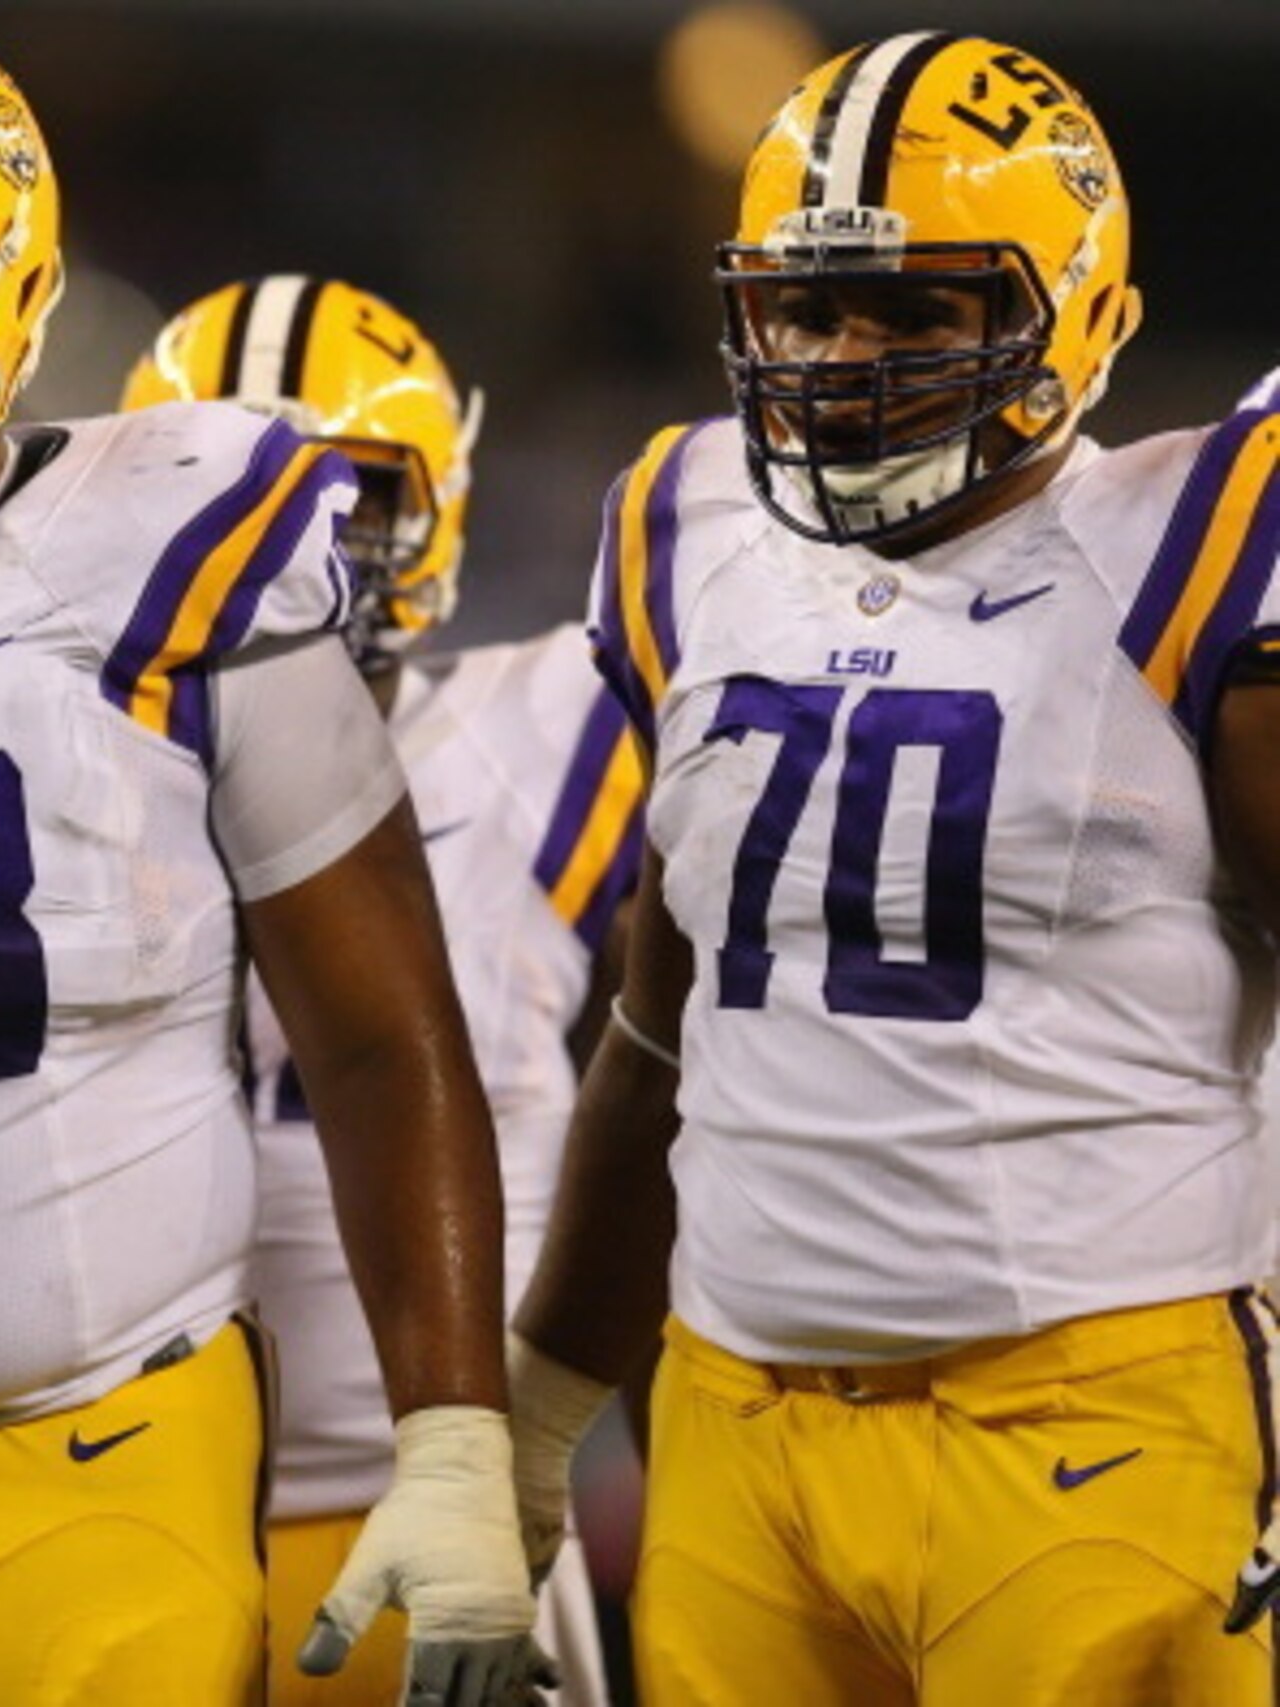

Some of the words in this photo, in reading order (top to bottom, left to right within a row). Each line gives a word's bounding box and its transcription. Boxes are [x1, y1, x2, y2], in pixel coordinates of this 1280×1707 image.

[948, 53, 1061, 150] LS
[827, 649, 898, 678] LSU
[702, 673, 1004, 1022] 70
